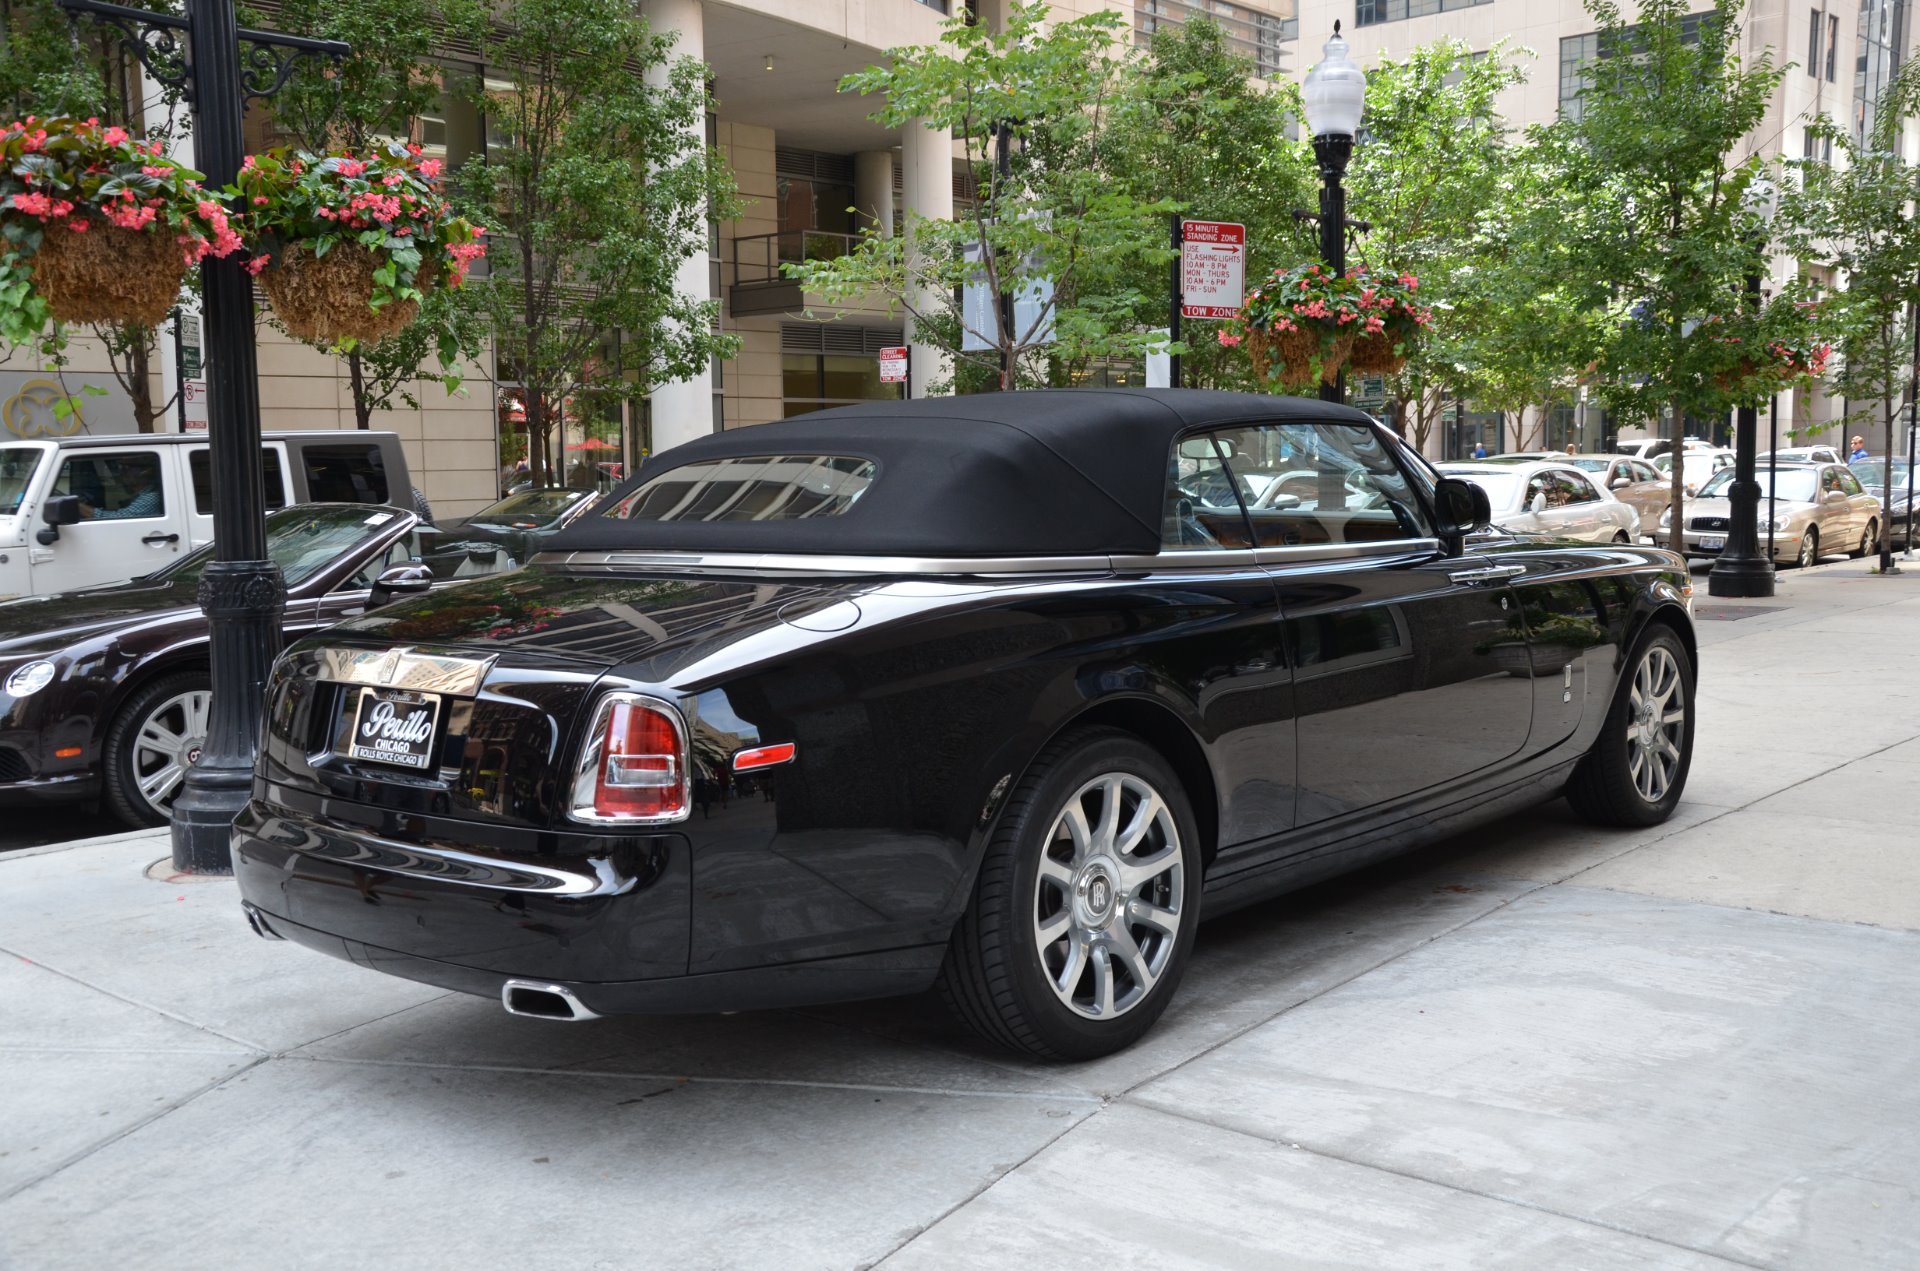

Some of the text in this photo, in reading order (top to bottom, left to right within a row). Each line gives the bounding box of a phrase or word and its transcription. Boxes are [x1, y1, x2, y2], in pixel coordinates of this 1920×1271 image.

[1187, 224, 1219, 233] 15 MINUTE
[1187, 233, 1238, 242] STANDING ZONE
[1186, 253, 1217, 261] FLASHING
[1208, 270, 1230, 278] THURS
[1187, 306, 1207, 315] TOW
[362, 701, 432, 743] Perillo
[375, 738, 410, 753] CHICAGO
[360, 748, 417, 765] ROLLS ROYCE CHICAGO
